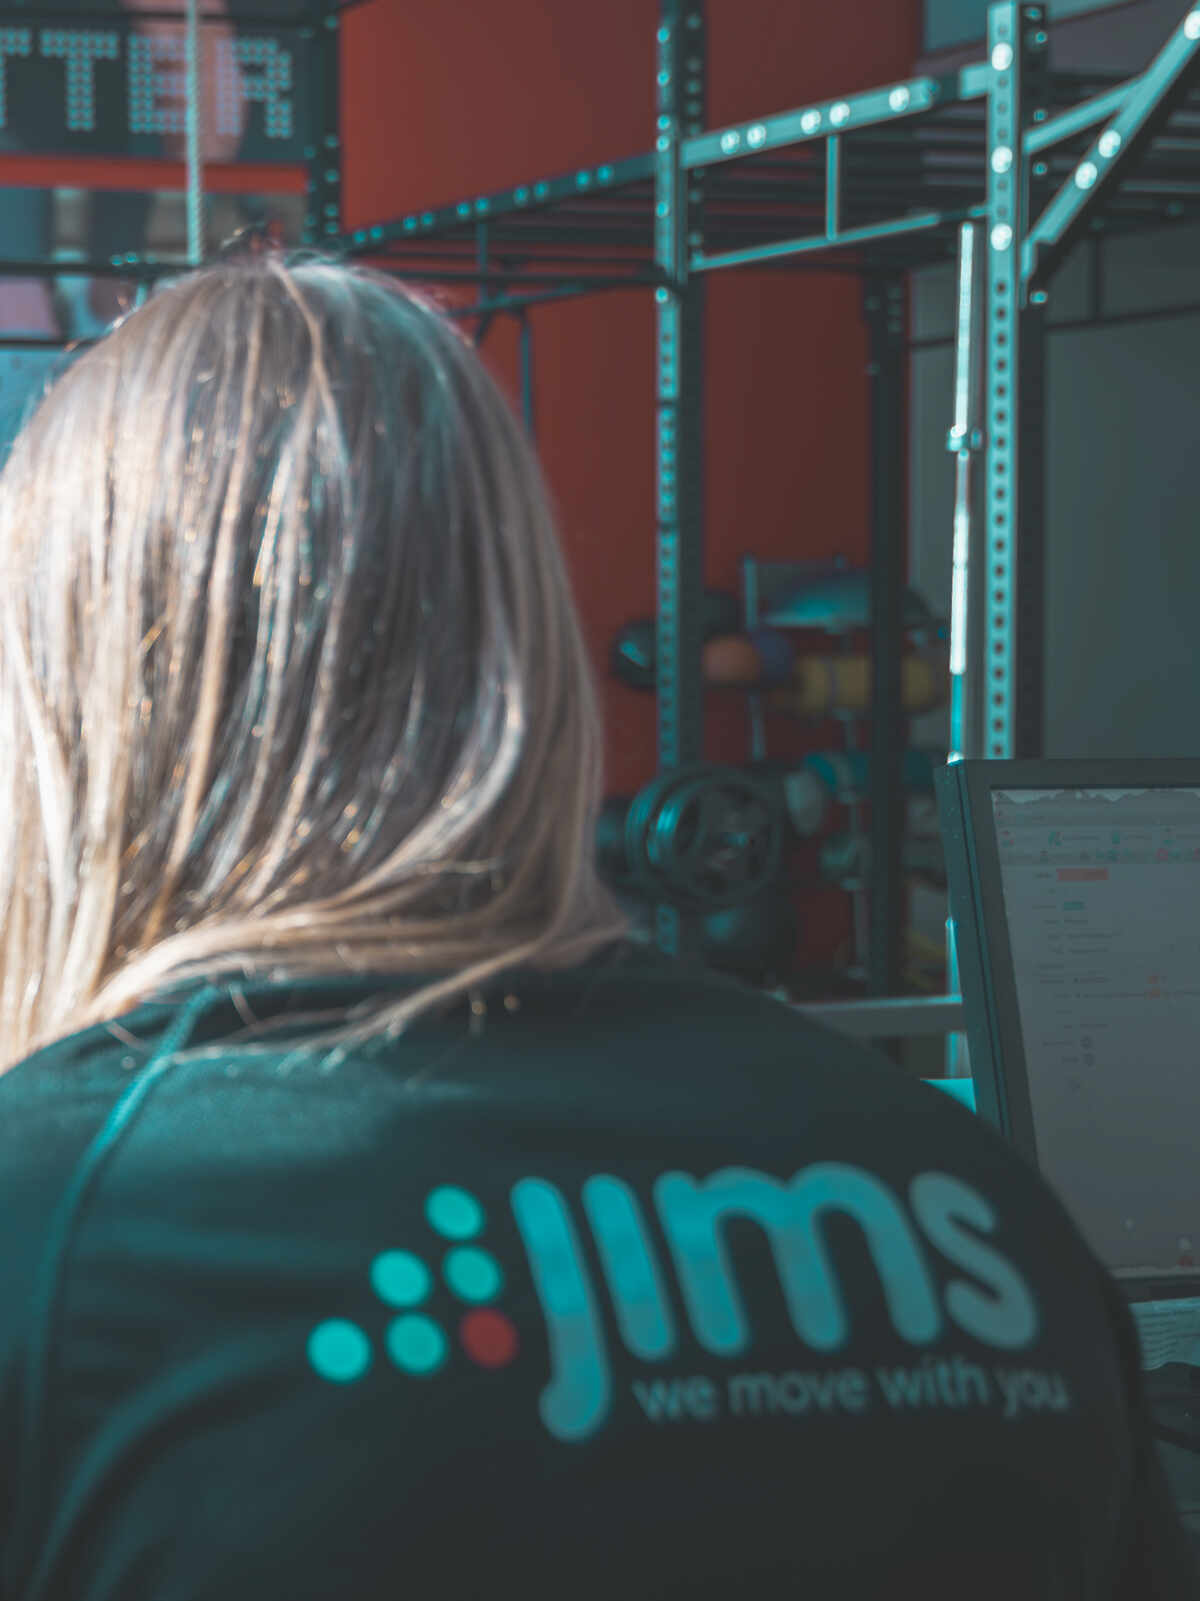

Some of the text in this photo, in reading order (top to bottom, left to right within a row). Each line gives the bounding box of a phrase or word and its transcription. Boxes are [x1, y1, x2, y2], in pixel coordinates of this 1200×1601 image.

[632, 1353, 1069, 1422] we move with you
